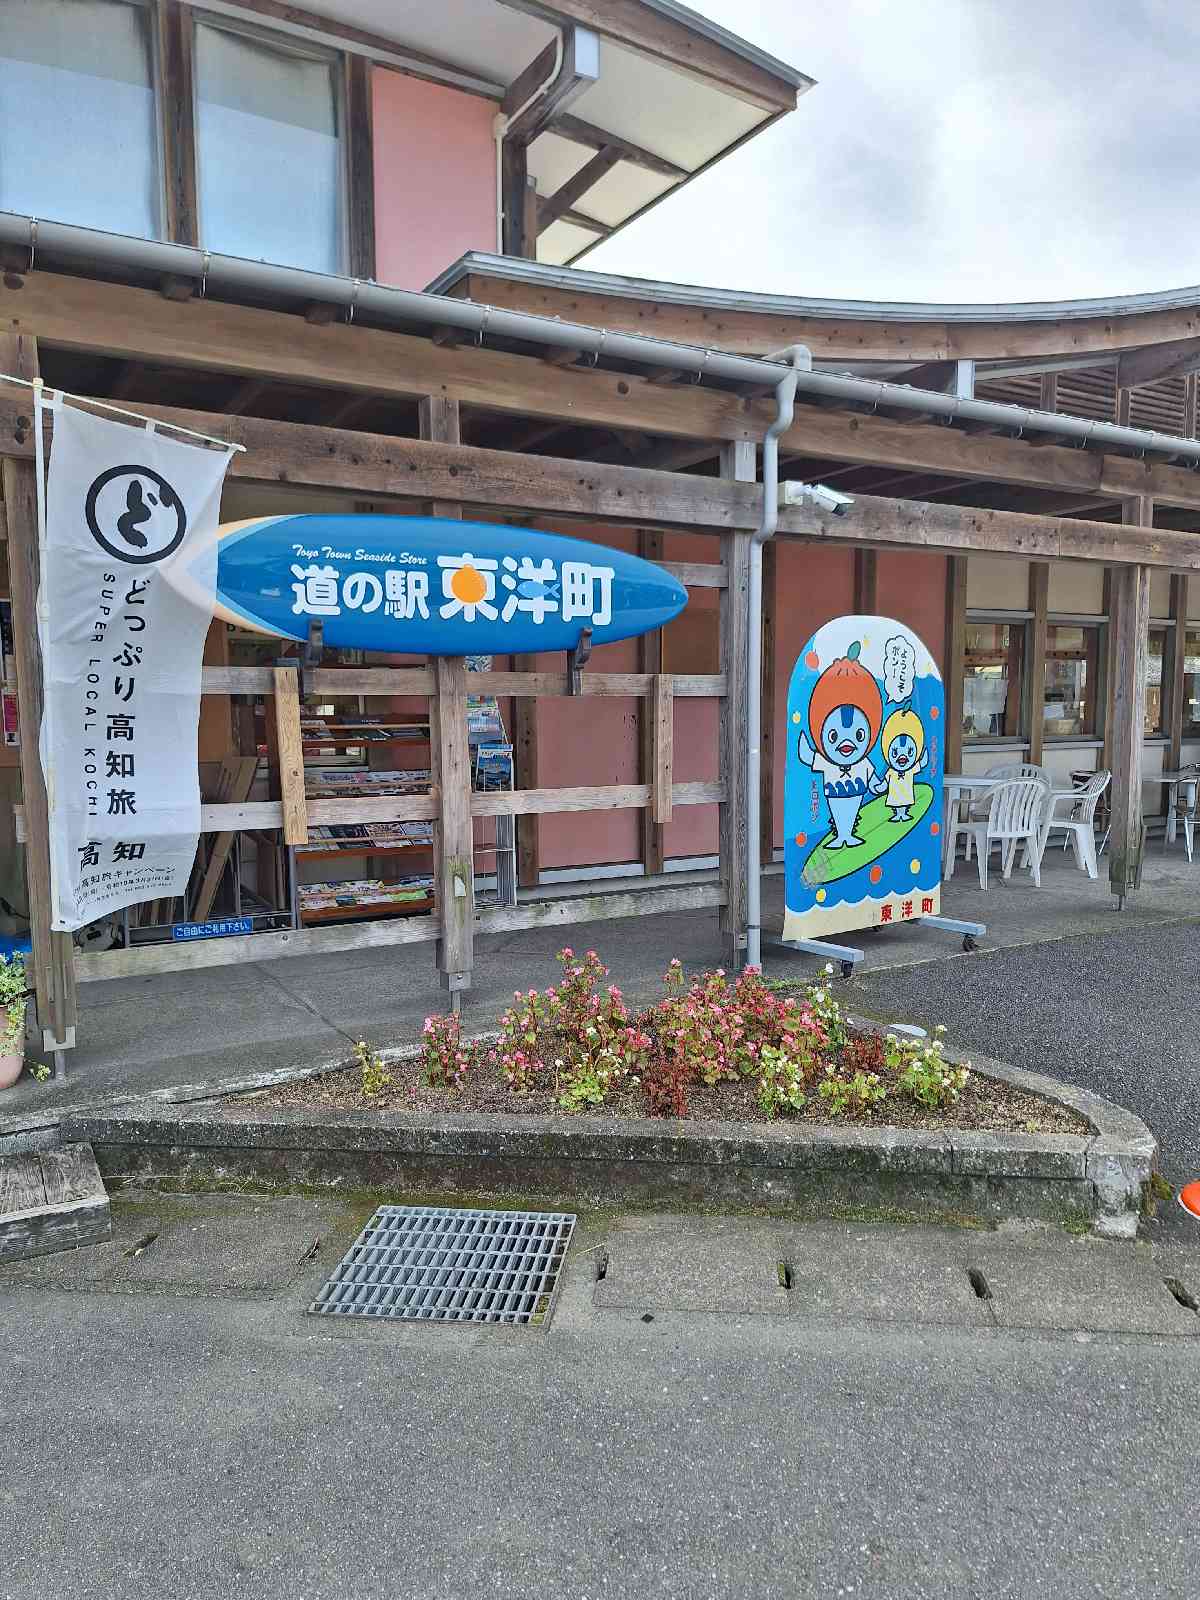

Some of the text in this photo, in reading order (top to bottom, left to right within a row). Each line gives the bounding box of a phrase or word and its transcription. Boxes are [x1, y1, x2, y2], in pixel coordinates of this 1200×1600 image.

[291, 553, 616, 626] 道の駅 東洋町
[292, 543, 428, 566] Toyo Town Seaside Store
[83, 572, 116, 816] SUPER LOCAL KOCHI
[105, 578, 151, 816] どっぷり高知旅
[880, 896, 935, 923] 東洋町
